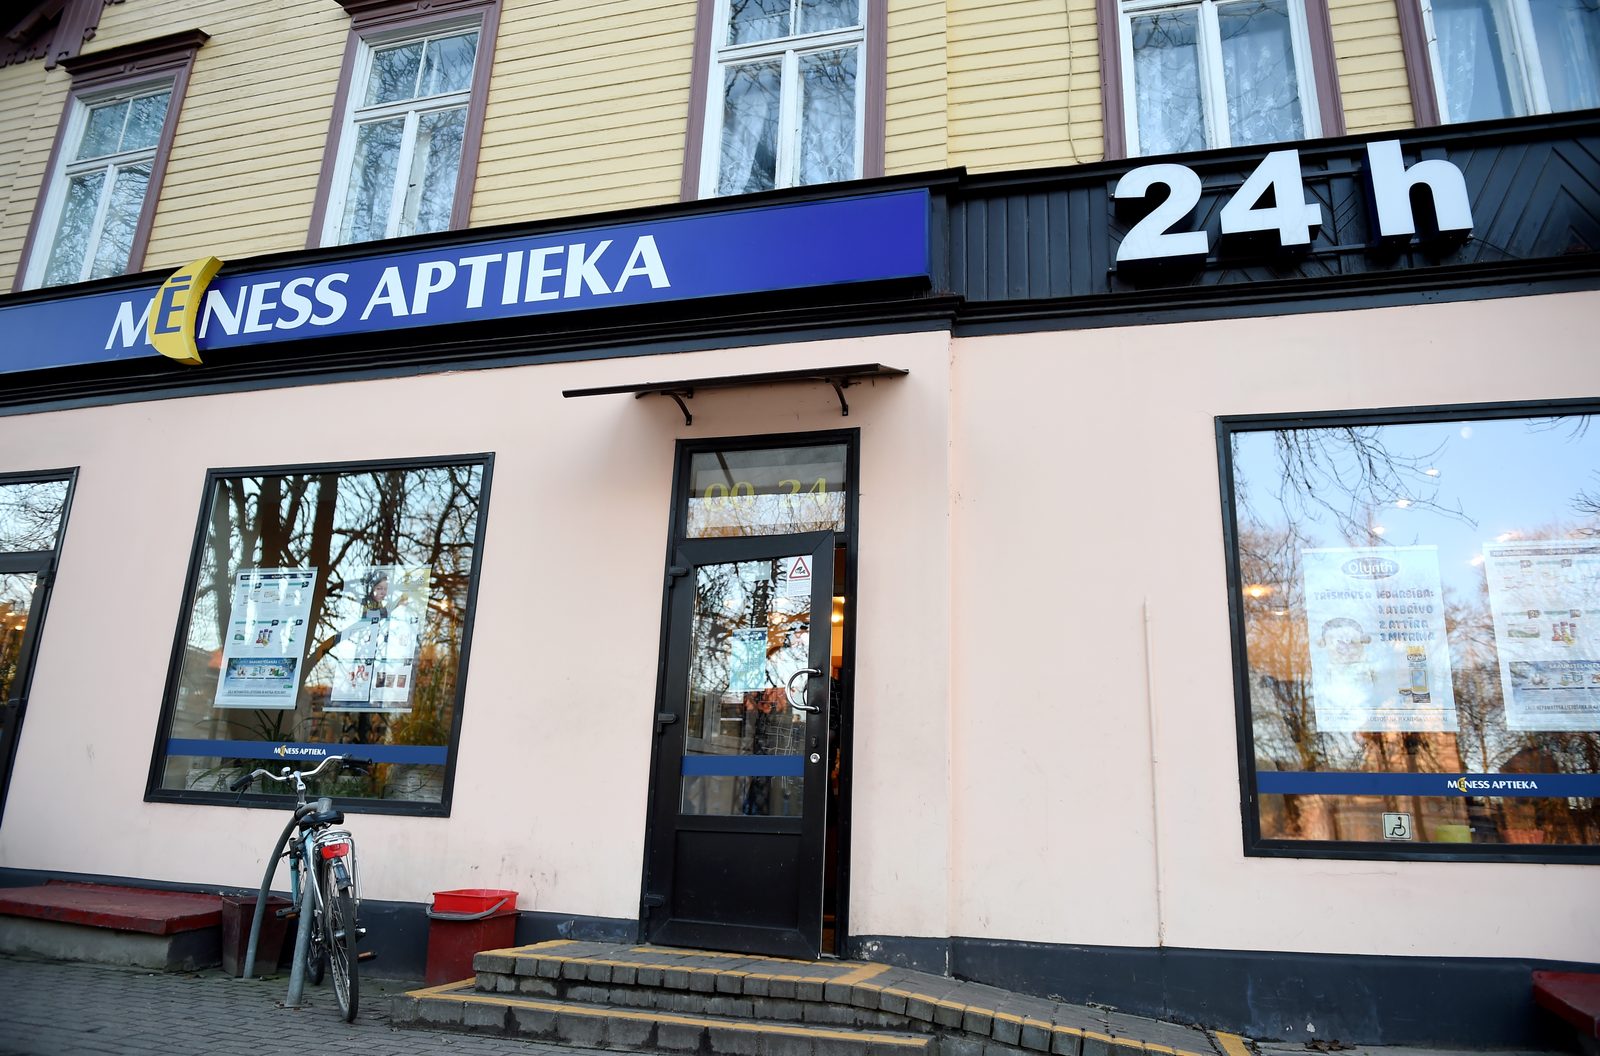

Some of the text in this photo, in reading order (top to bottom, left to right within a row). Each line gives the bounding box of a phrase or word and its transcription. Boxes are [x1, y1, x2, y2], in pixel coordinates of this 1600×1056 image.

[1114, 139, 1474, 263] 24 h
[104, 235, 672, 350] MĒNESS APTIEKA
[703, 477, 829, 512] 00 24
[299, 748, 327, 756] APTIEKA
[1491, 780, 1538, 789] APTIEKA
